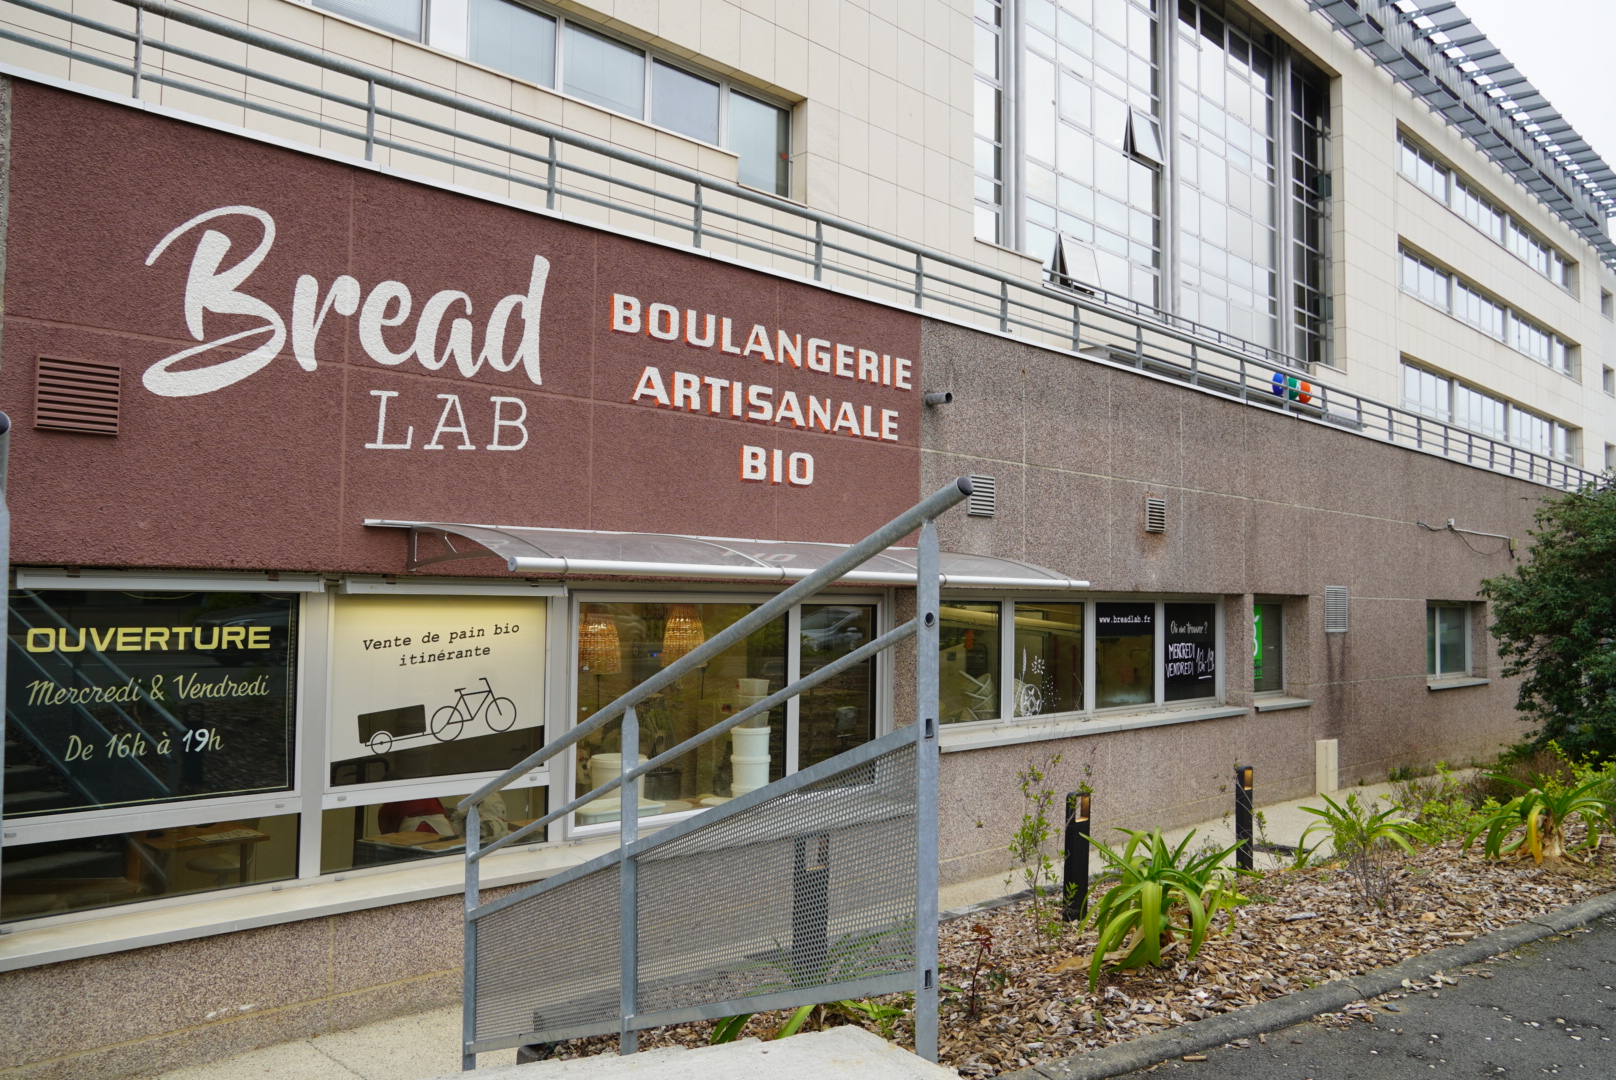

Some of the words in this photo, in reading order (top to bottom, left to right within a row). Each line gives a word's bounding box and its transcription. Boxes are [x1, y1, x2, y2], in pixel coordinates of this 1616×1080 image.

[142, 205, 551, 398] Bread
[610, 293, 914, 392] BOULANGERIE
[364, 389, 529, 452] LAB
[631, 365, 900, 443] ARTISANALE
[740, 445, 816, 487] BIO
[1098, 614, 1151, 624] www.breadlab.fr
[26, 626, 272, 653] OUVERTURE
[363, 636, 412, 651] Vente
[421, 631, 440, 644] de
[448, 626, 485, 644] pain
[493, 623, 520, 636] bio
[1168, 642, 1196, 660] MERCREDI
[398, 646, 491, 667] itinérante
[1165, 661, 1194, 678] VENDREDI
[25, 677, 142, 707] Mercredi
[150, 674, 165, 701] &
[172, 672, 270, 700] Vendredi
[64, 734, 94, 762] De
[105, 732, 147, 759] 16h
[156, 731, 172, 755] à
[181, 727, 224, 752] 19h
